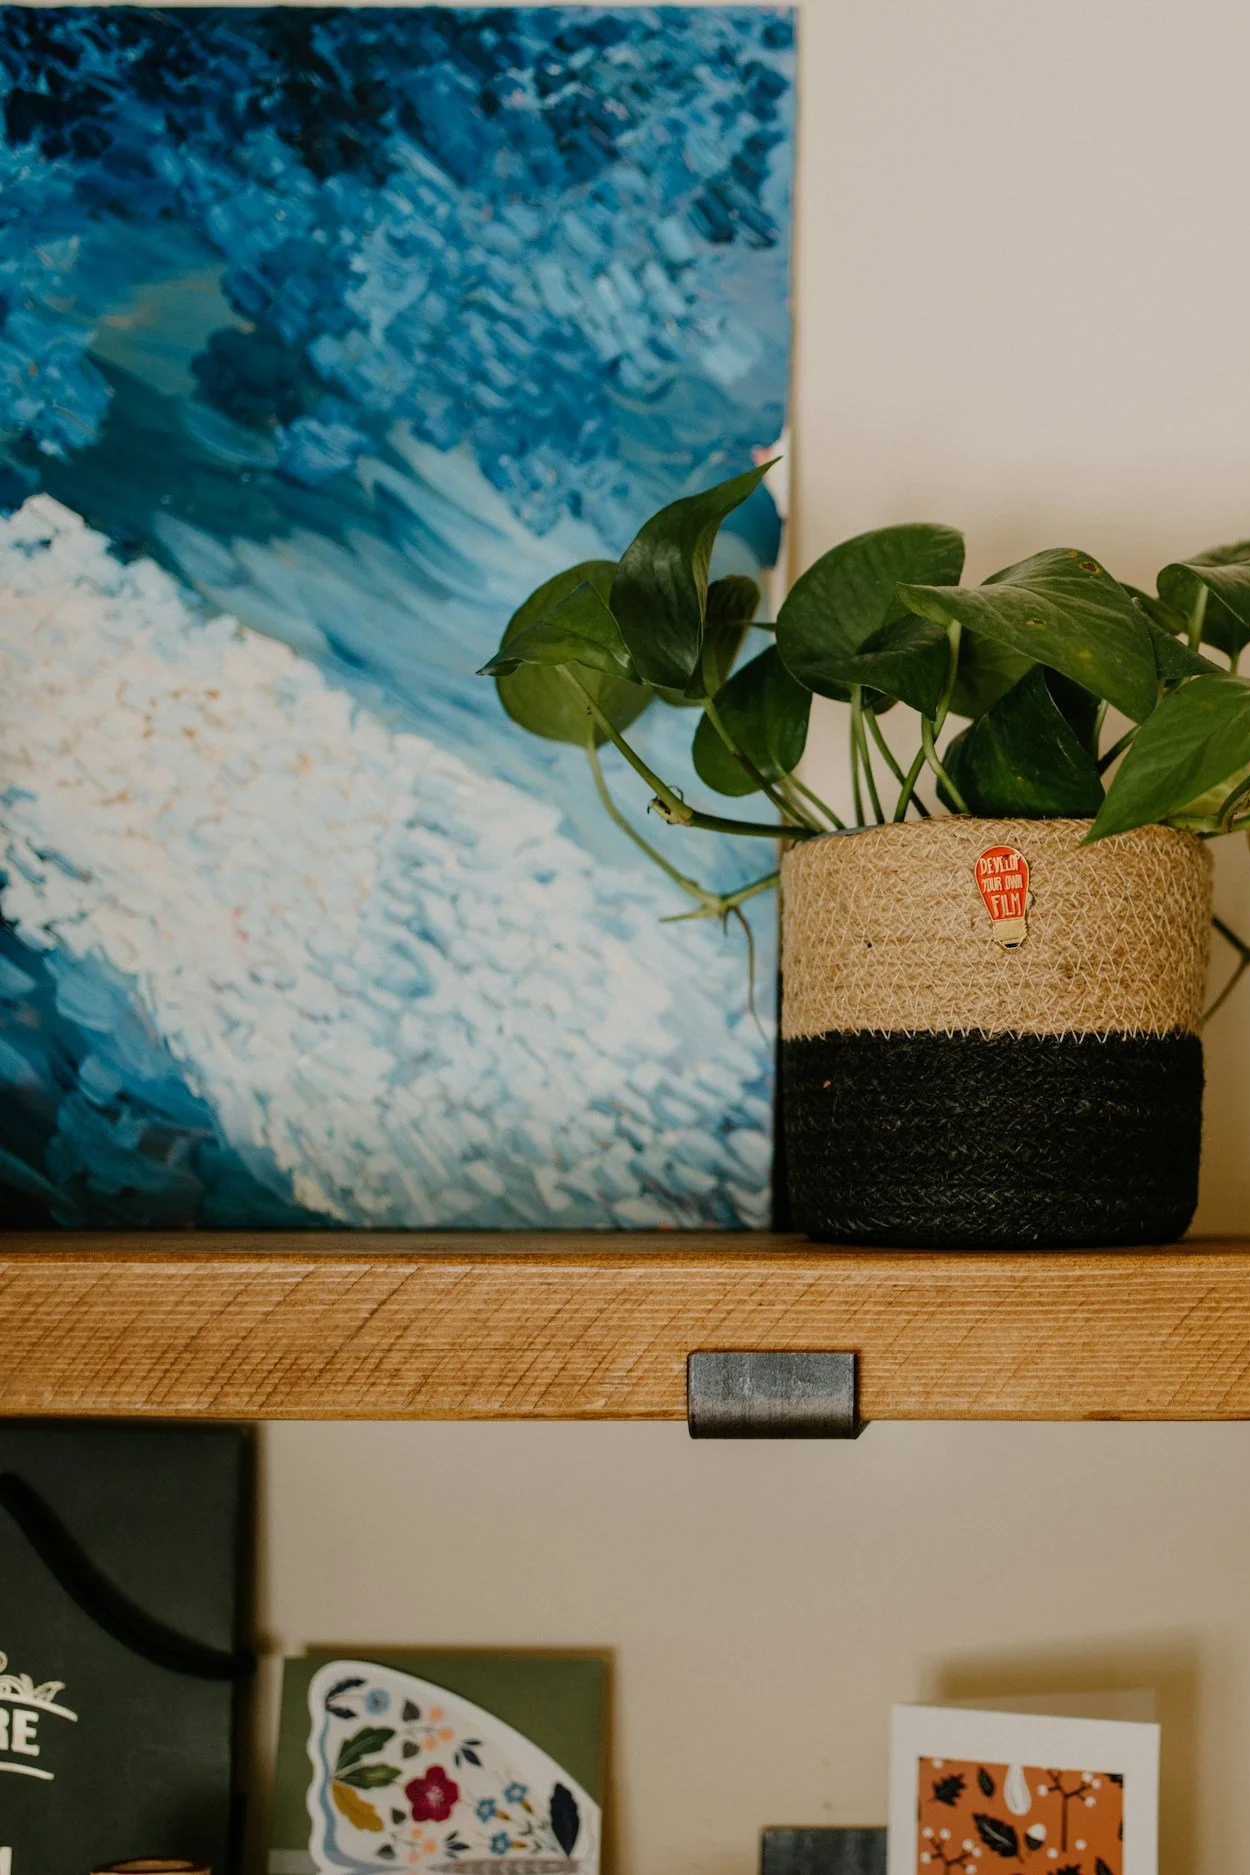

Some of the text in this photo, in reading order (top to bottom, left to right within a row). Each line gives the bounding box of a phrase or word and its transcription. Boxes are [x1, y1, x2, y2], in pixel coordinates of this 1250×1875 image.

[980, 853, 1020, 875] DEVELOP
[981, 874, 1023, 893] YOUR OWN
[991, 892, 1022, 918] FILM
